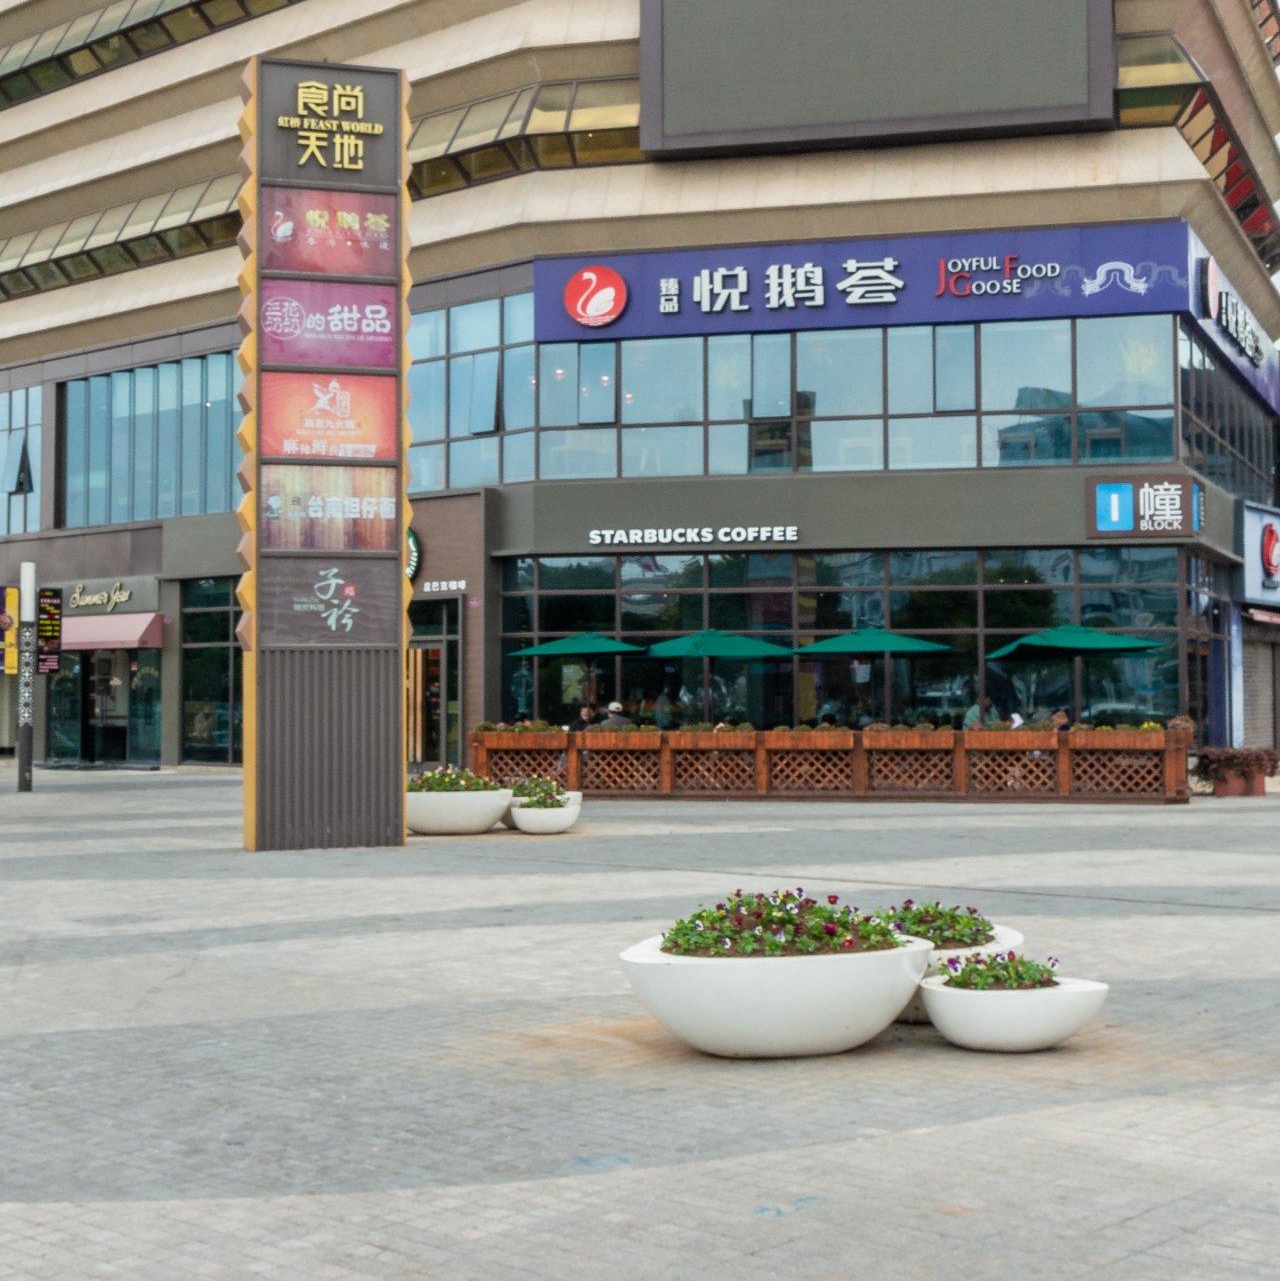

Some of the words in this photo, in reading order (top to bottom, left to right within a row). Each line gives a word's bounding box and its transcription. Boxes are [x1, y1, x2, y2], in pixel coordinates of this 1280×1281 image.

[297, 80, 365, 119] 食尚
[303, 118, 339, 132] FEAST
[341, 120, 384, 135] WORLD
[297, 130, 365, 170] 天地
[692, 256, 905, 313] 悦鹅荟
[935, 256, 1001, 297] JOYFUL
[1003, 253, 1061, 279] FOOD
[949, 272, 1022, 297] GOOSE
[1139, 481, 1183, 521] 幢
[589, 527, 714, 545] STARBUCKS
[717, 526, 799, 542] COFFEE
[1140, 520, 1183, 531] BLOCK
